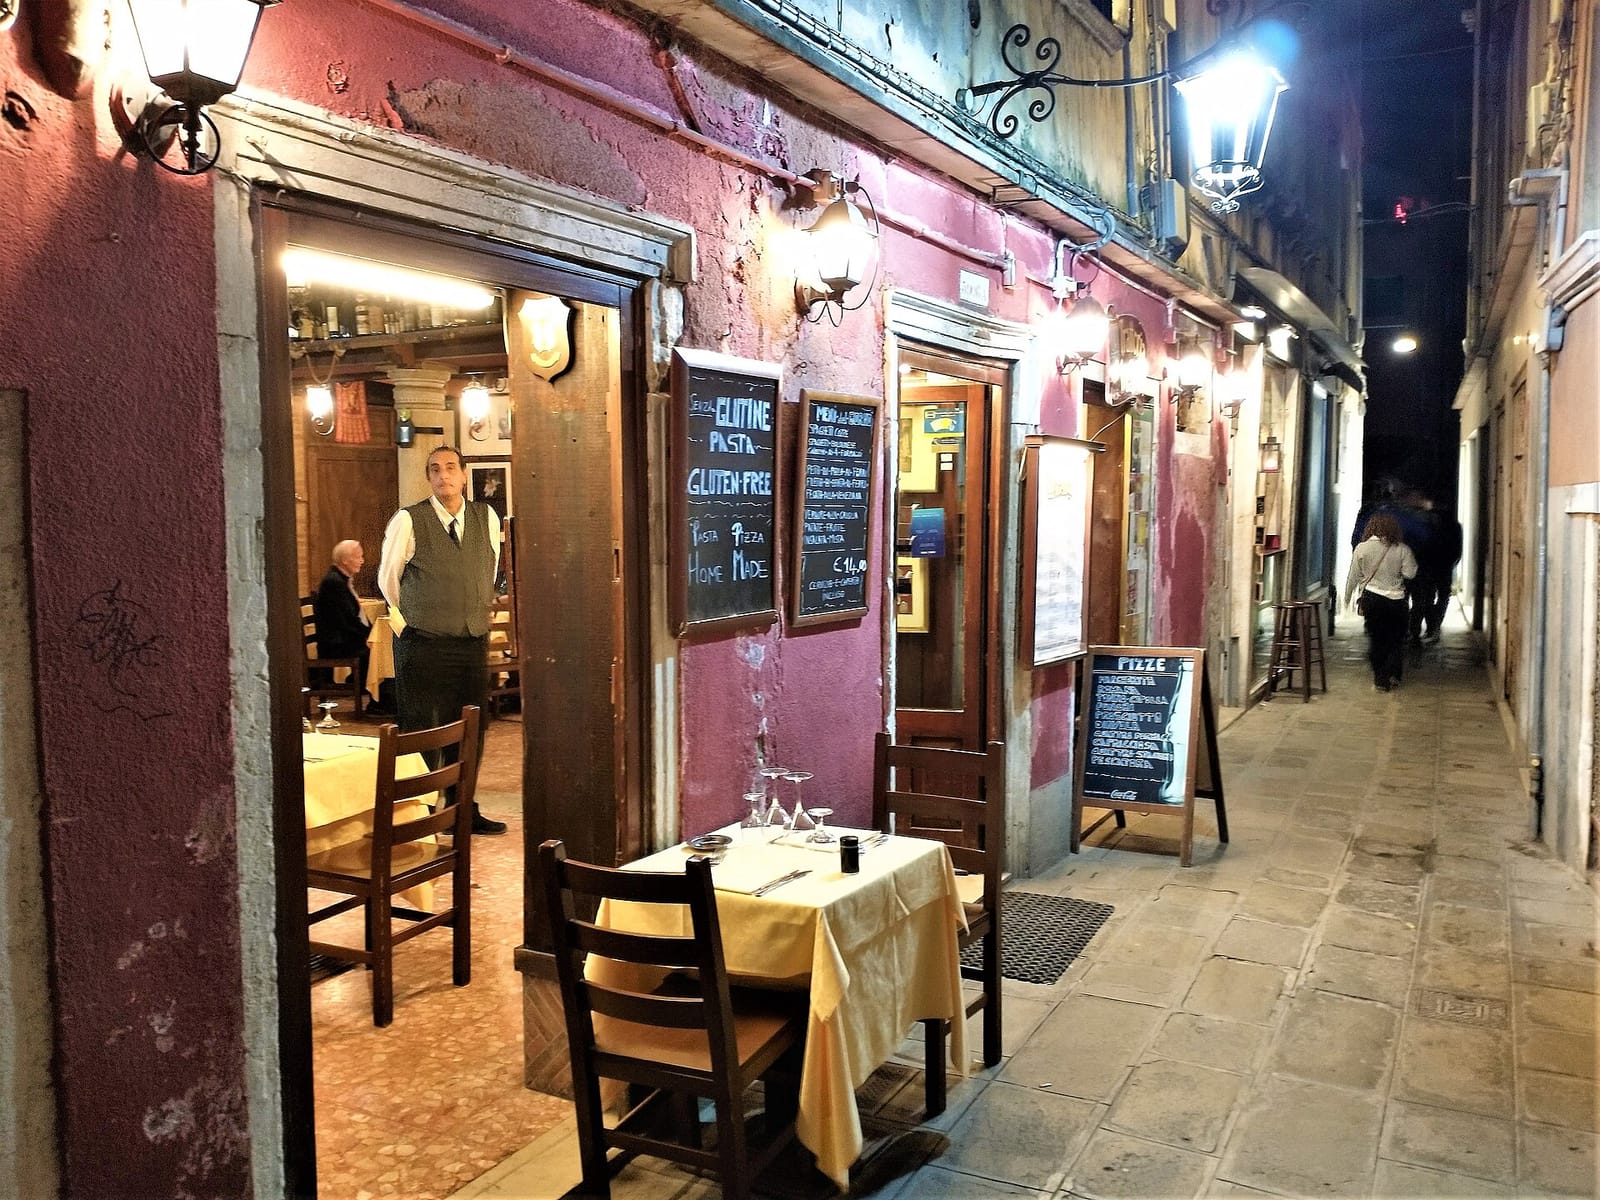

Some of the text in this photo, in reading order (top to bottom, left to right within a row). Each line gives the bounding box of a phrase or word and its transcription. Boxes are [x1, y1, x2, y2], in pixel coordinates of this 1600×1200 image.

[715, 396, 771, 431] GLUTINE
[709, 431, 756, 454] PASTA
[690, 520, 765, 547] PASTA PIZZA
[688, 550, 769, 585] HOME MADE
[1118, 657, 1166, 671] PIZZE
